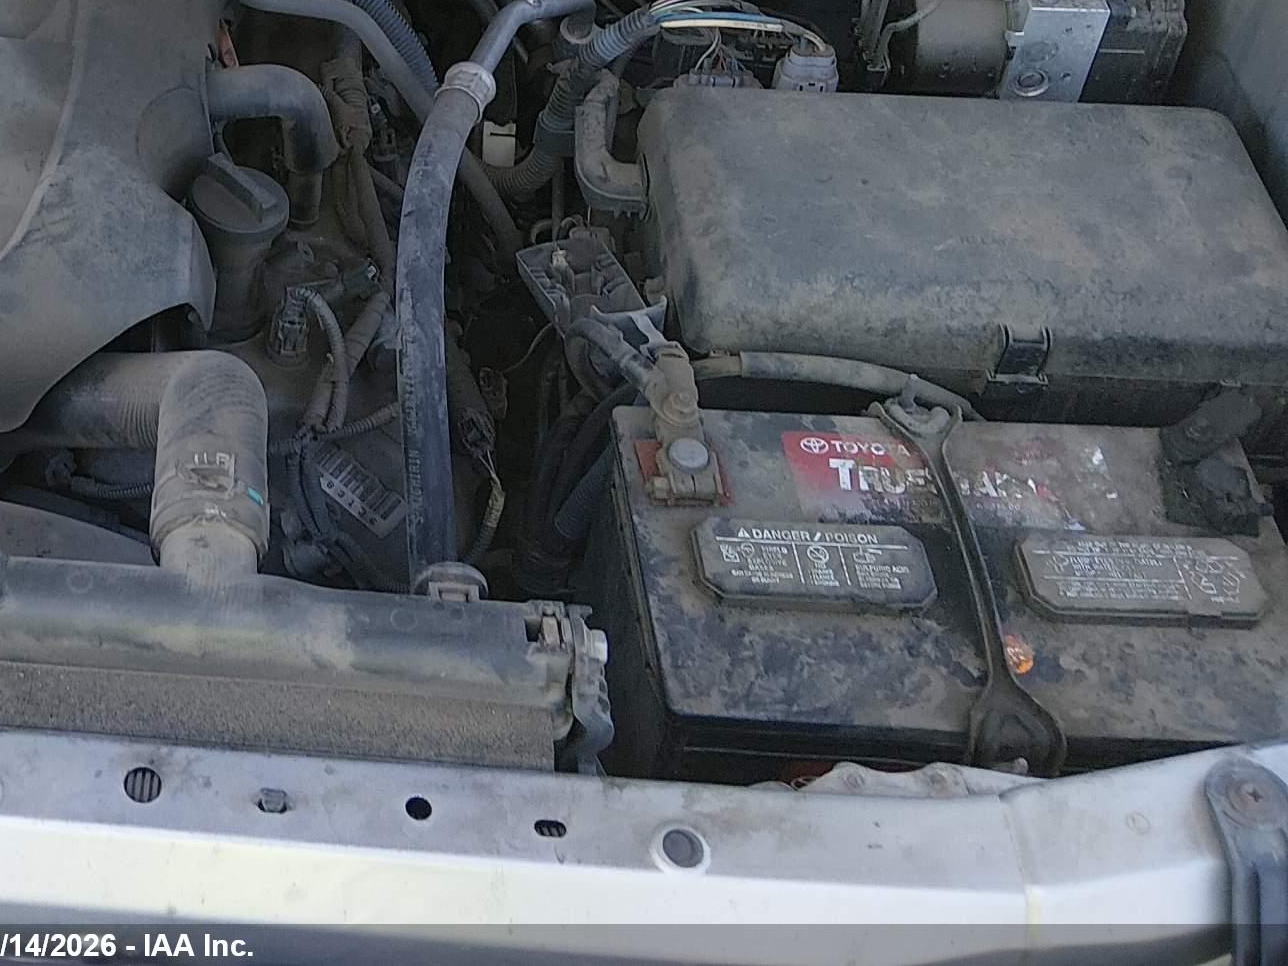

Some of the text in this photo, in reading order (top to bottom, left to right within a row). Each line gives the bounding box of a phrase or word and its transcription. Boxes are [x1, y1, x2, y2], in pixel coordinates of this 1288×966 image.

[830, 439, 911, 457] TOYOA
[751, 529, 811, 542] DANGER
[824, 533, 879, 544] POISON
